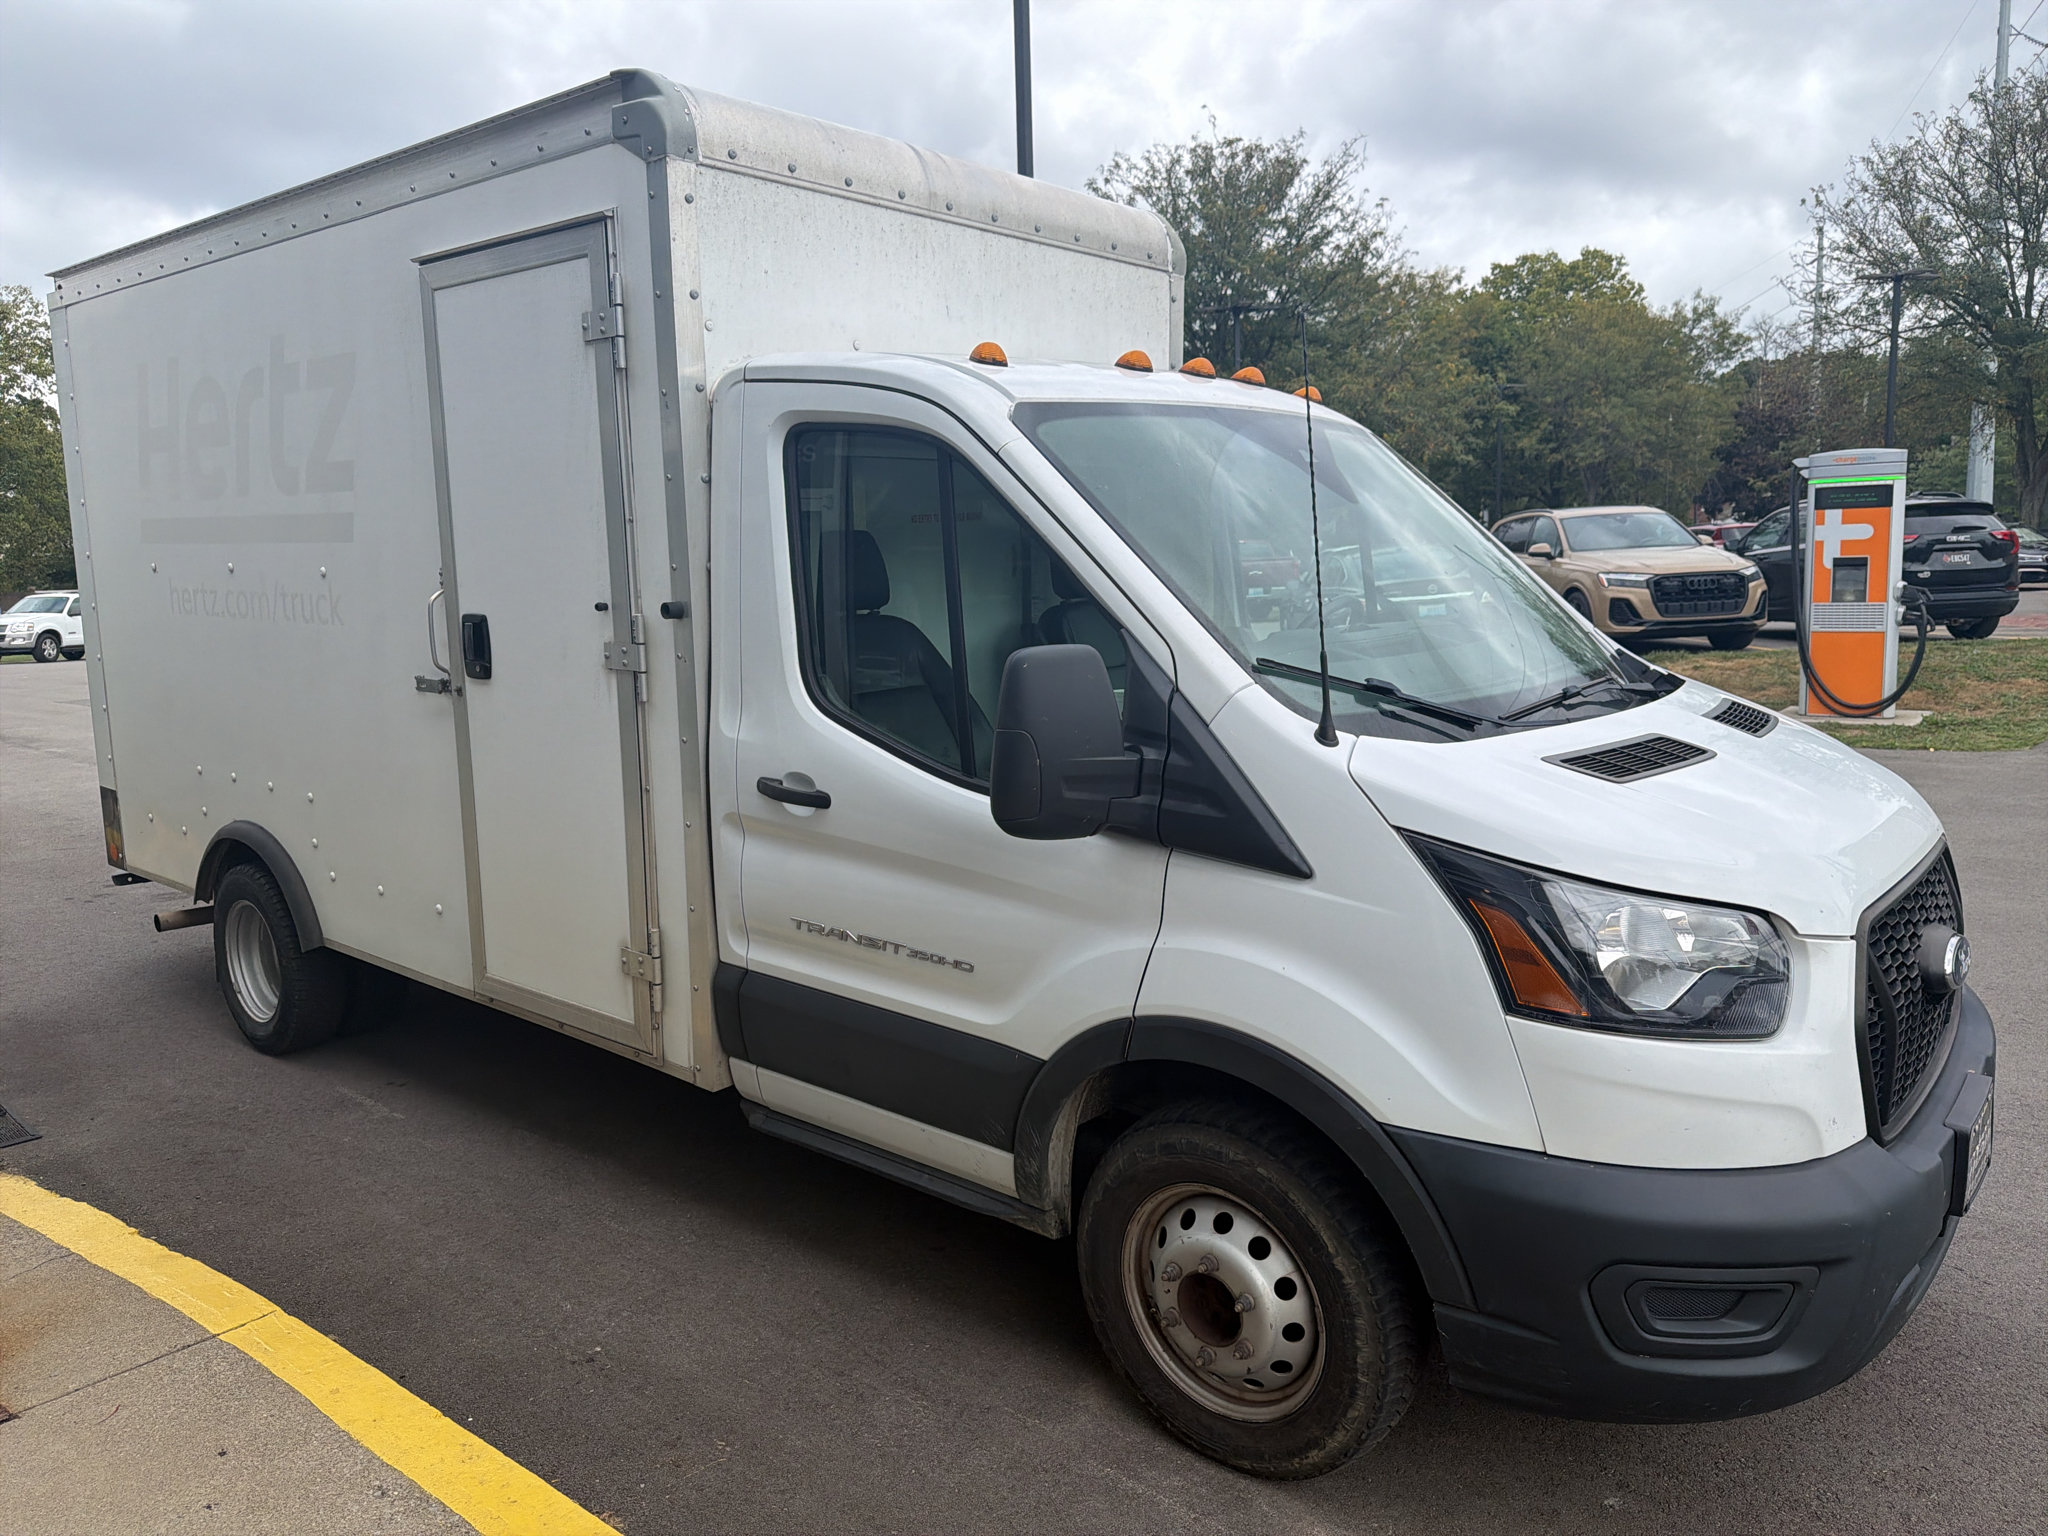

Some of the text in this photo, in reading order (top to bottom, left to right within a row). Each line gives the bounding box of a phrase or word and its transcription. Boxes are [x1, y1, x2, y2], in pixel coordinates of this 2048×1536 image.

[137, 333, 356, 501] Hertz
[168, 576, 344, 627] hertz.com/truck
[790, 916, 975, 973] TRANSIT 350HD
